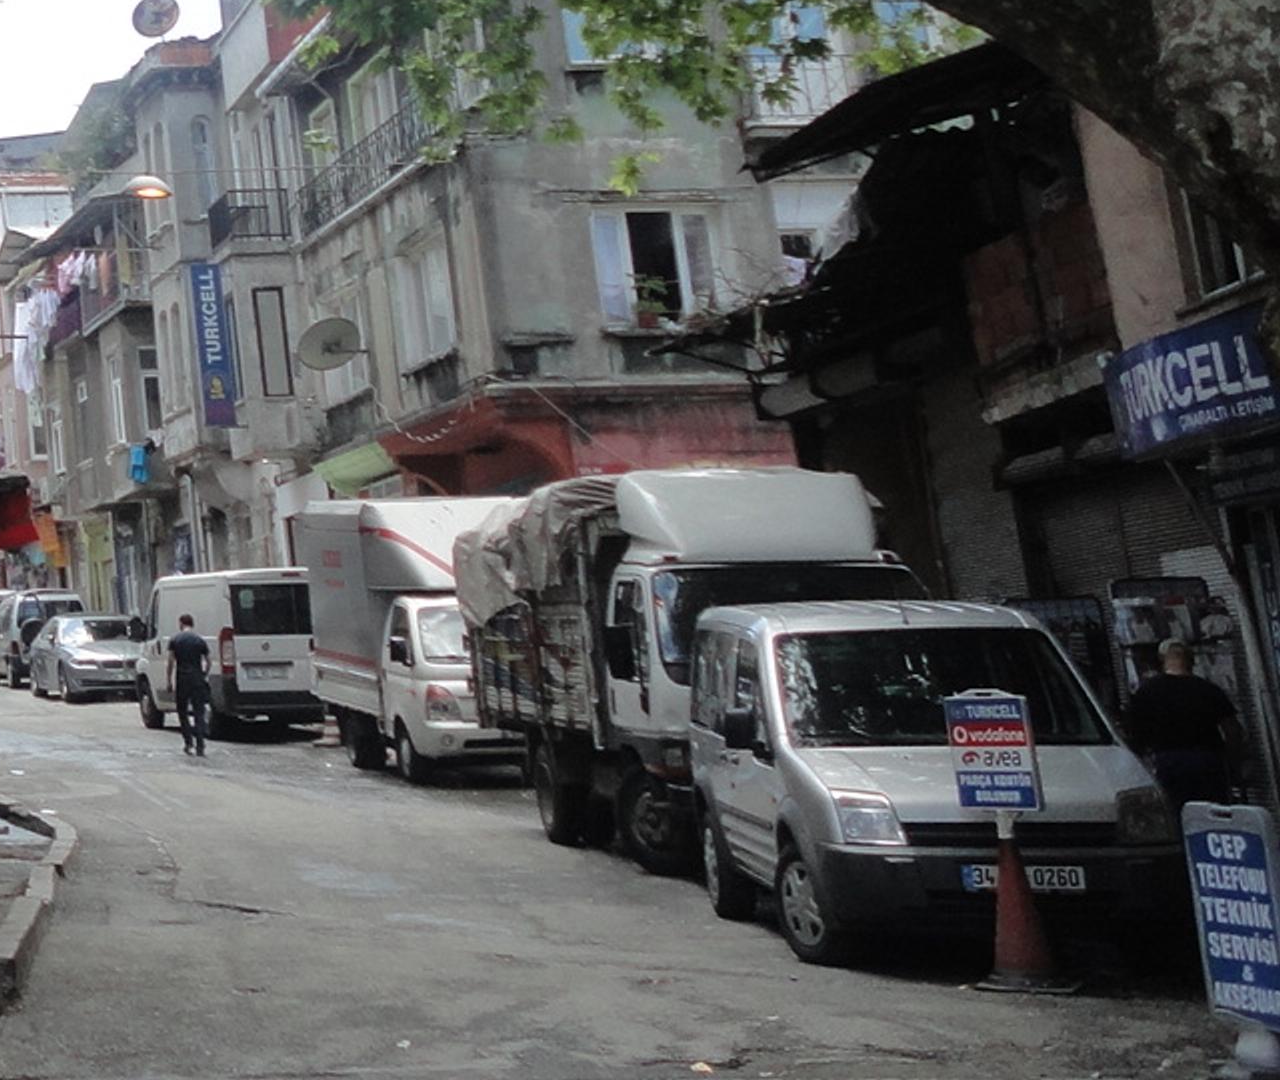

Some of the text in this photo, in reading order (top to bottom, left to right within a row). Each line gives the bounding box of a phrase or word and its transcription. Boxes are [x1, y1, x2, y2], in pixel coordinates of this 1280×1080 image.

[198, 269, 223, 364] TURKCELL
[1119, 335, 1270, 424] TURKCELL
[965, 704, 1021, 719] TURKCELL
[969, 726, 1025, 742] vodafone
[983, 750, 1022, 767] avea
[1206, 832, 1248, 860] CEP
[973, 867, 1080, 888] 34 0260
[1196, 862, 1268, 895] TELEFONU
[1200, 896, 1273, 930] TEKNİK
[1207, 932, 1280, 966] SERVİSİ
[1242, 964, 1255, 983] &
